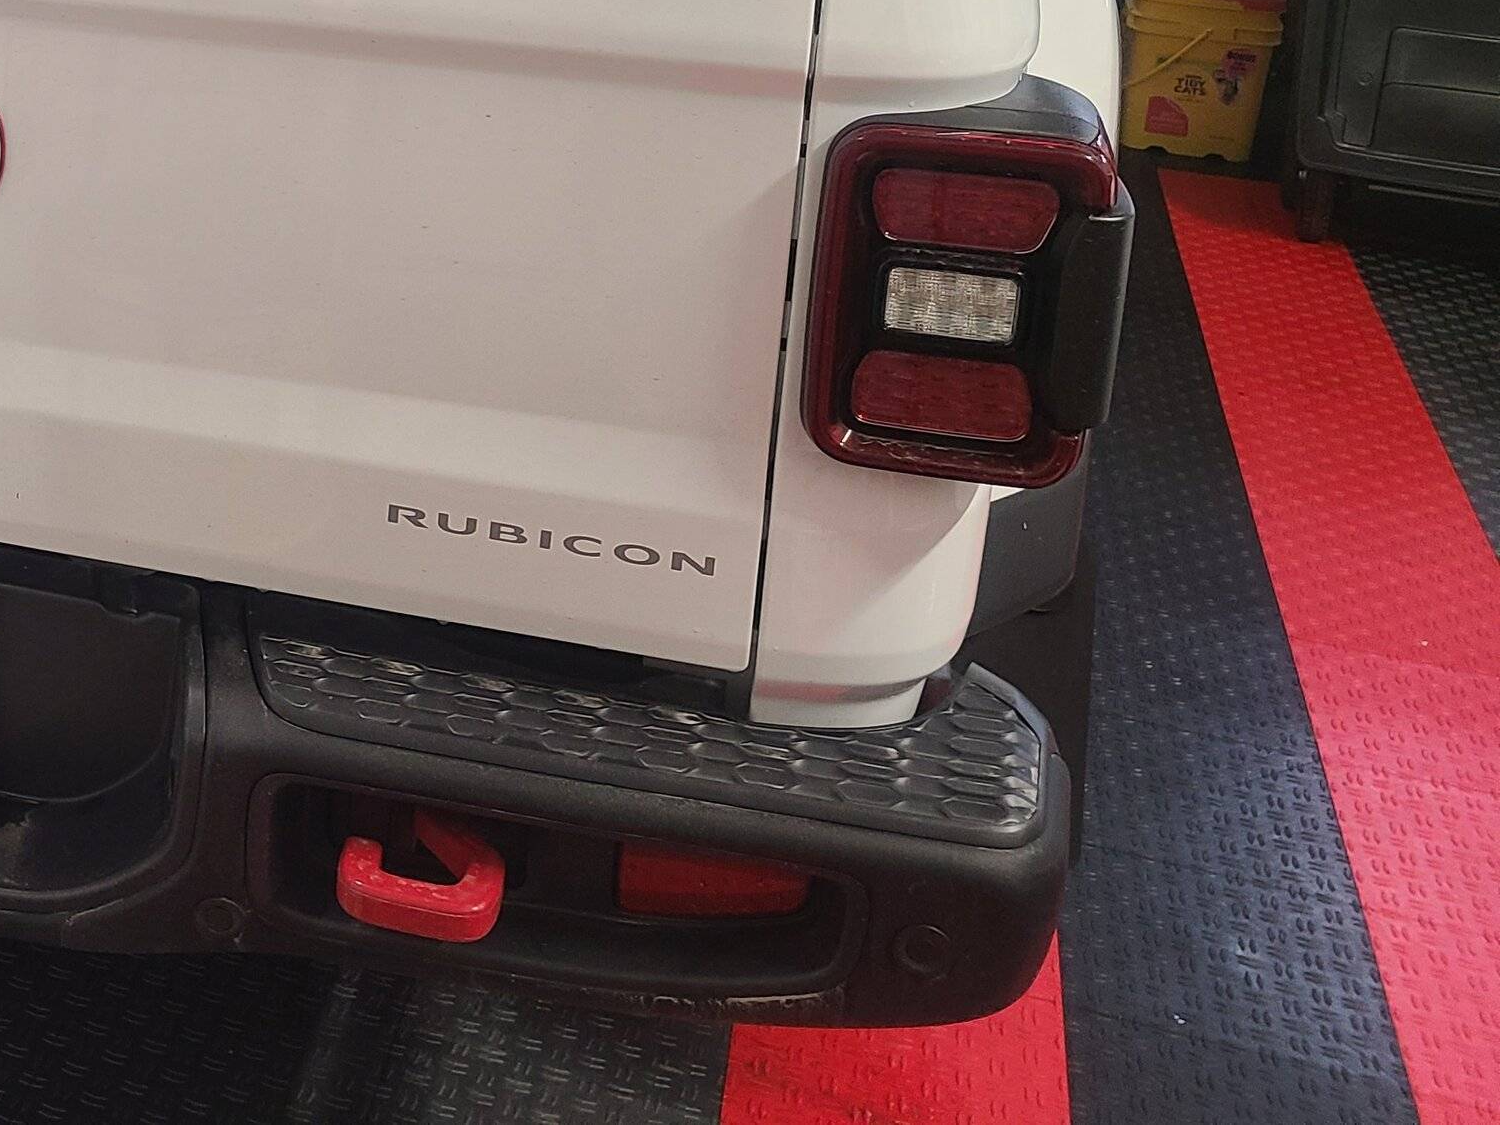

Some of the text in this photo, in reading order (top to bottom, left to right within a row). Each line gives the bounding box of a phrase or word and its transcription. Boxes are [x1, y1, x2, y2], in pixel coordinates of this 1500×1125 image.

[1176, 77, 1207, 89] TIDY
[1173, 87, 1208, 97] CATS
[387, 503, 717, 577] RUBICON
